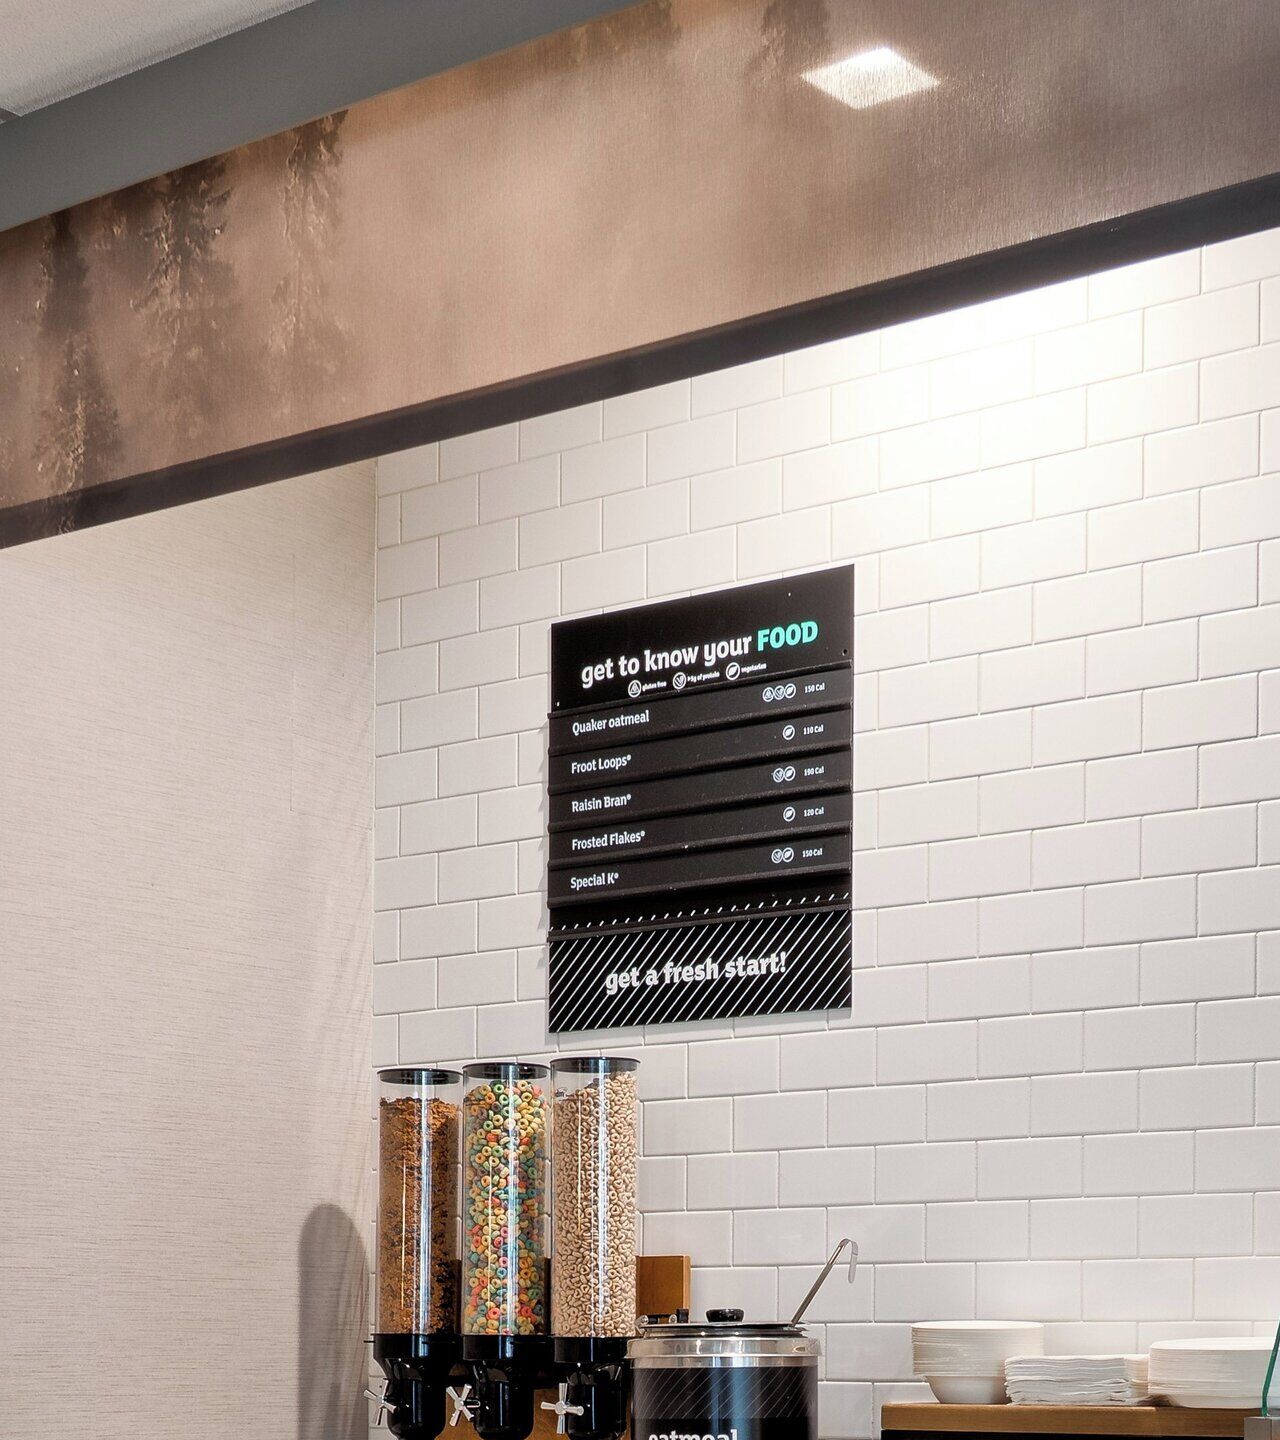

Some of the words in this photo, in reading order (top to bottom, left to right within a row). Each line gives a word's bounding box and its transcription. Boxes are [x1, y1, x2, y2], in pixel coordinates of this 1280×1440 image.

[581, 657, 614, 688] get
[619, 655, 640, 677] to
[644, 645, 699, 672] know
[704, 635, 752, 667] your
[757, 620, 819, 652] FOOD
[815, 682, 825, 691] Cal
[572, 718, 607, 736] Quaker
[608, 709, 650, 729] oatmeal
[814, 724, 824, 733] Cal
[571, 759, 597, 774] Froot
[814, 766, 824, 775] Cal
[571, 798, 602, 813] Raisin
[814, 807, 824, 815] Cal
[571, 833, 608, 851] Frosted
[813, 848, 823, 856] Cal
[570, 873, 606, 891] Special
[605, 966, 640, 995] get
[645, 969, 659, 986] a
[664, 957, 719, 984] fresh
[725, 951, 787, 978] start!
